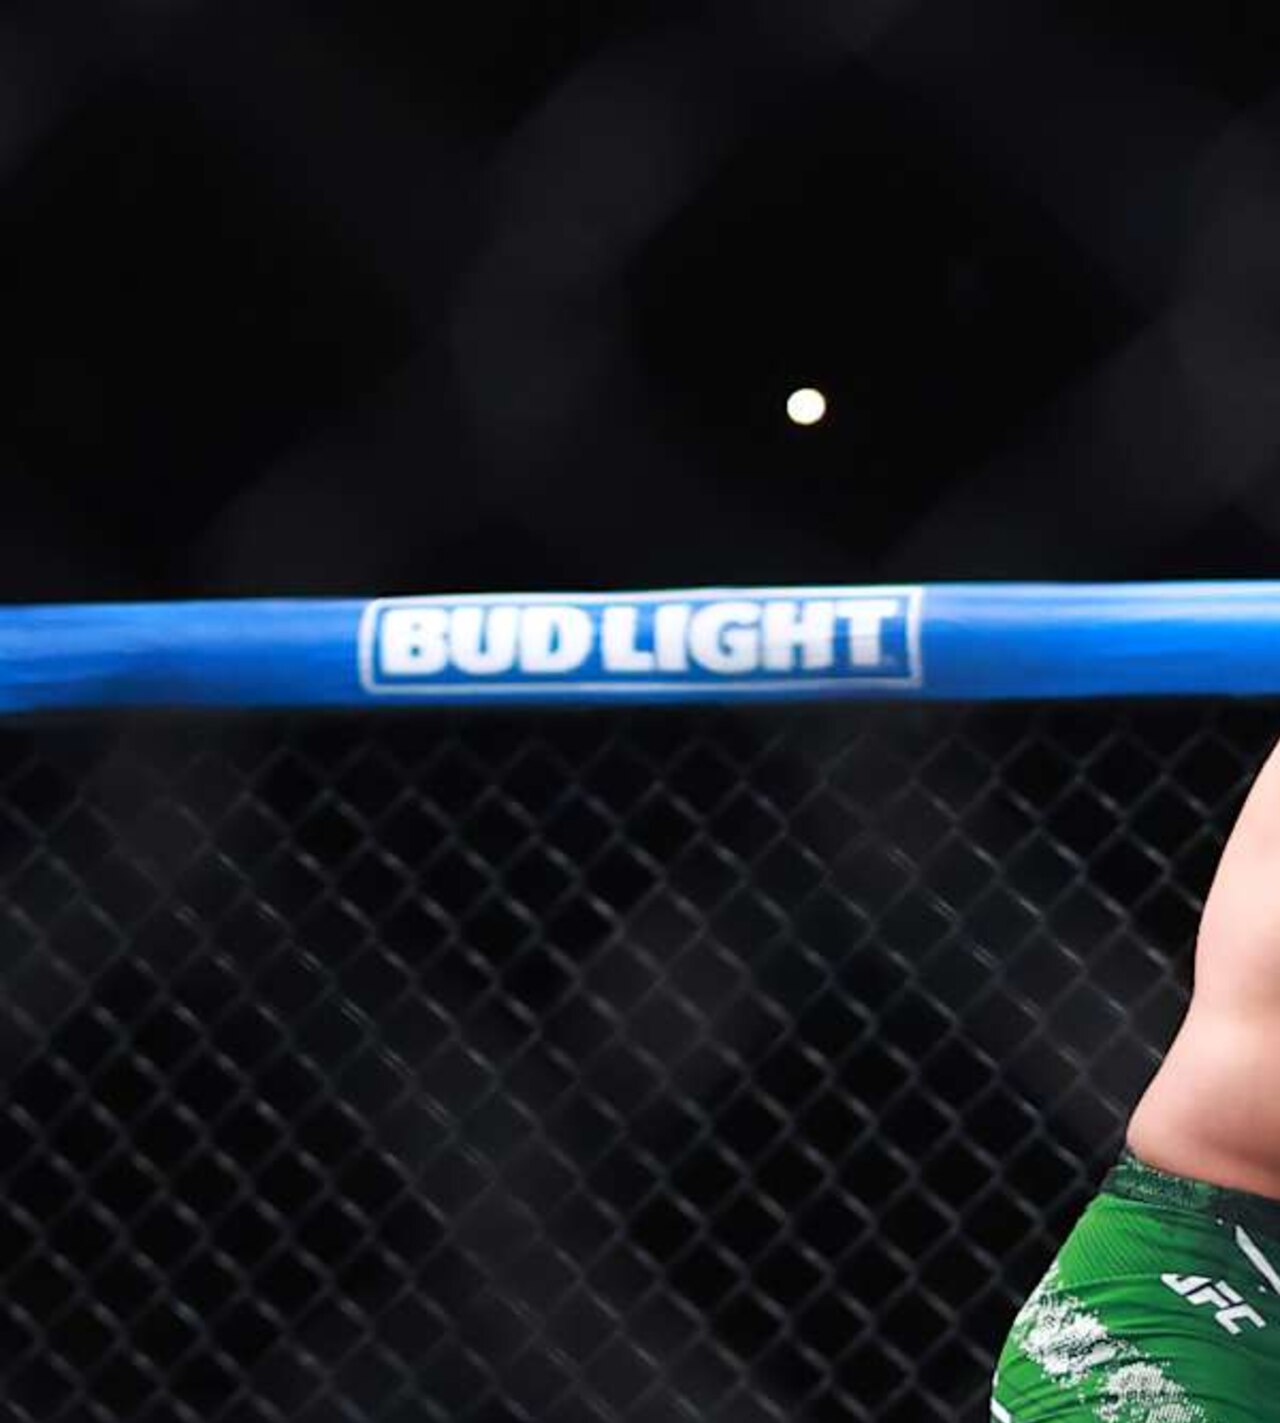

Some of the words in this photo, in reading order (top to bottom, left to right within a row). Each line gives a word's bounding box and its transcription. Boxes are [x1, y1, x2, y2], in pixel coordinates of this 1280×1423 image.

[381, 605, 593, 675] BUD
[601, 599, 899, 674] LIGHT
[1161, 1273, 1267, 1335] UFC
